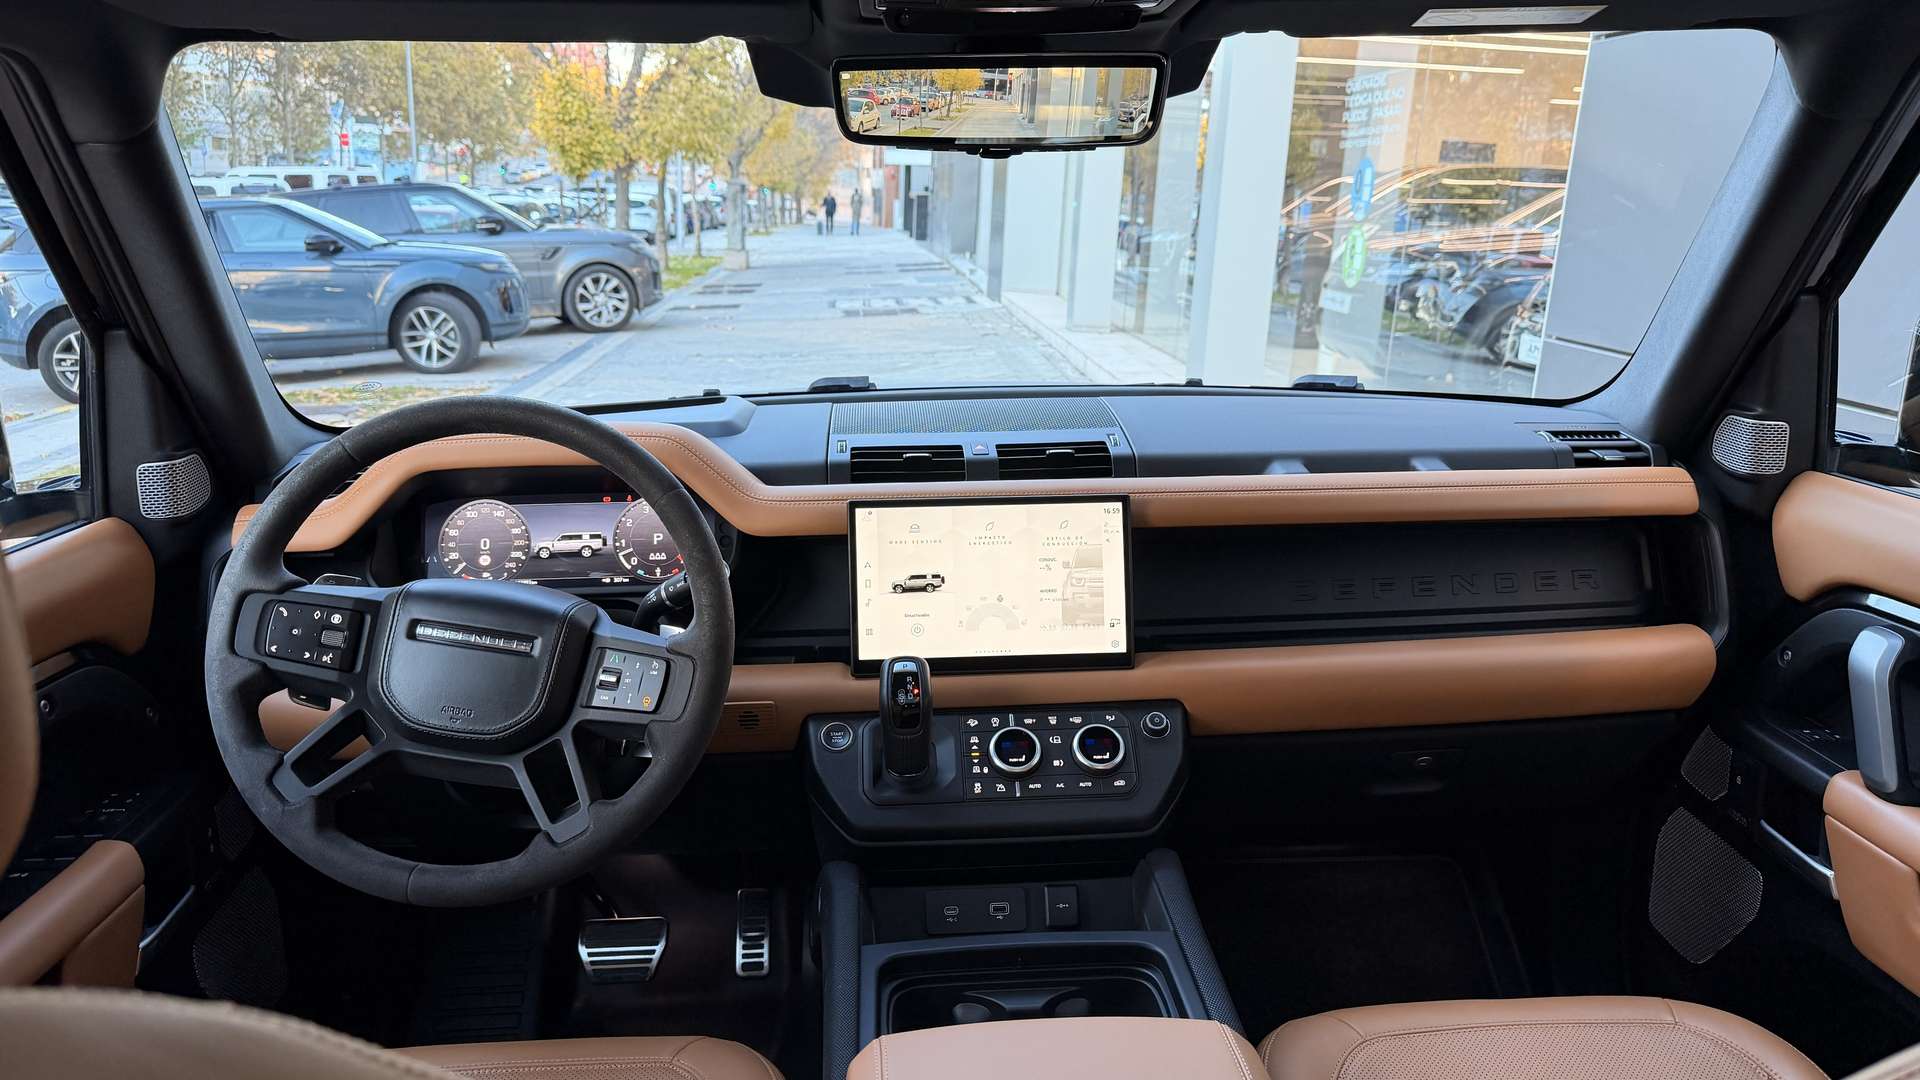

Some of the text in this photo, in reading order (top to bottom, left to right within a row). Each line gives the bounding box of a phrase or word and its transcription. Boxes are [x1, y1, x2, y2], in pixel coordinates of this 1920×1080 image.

[626, 518, 633, 527] 2
[480, 538, 490, 550] 0
[620, 539, 626, 547] 1
[653, 533, 664, 545] P
[630, 557, 638, 565] 0
[1291, 568, 1599, 602] DEFENDER
[441, 705, 474, 718] AIRBAG
